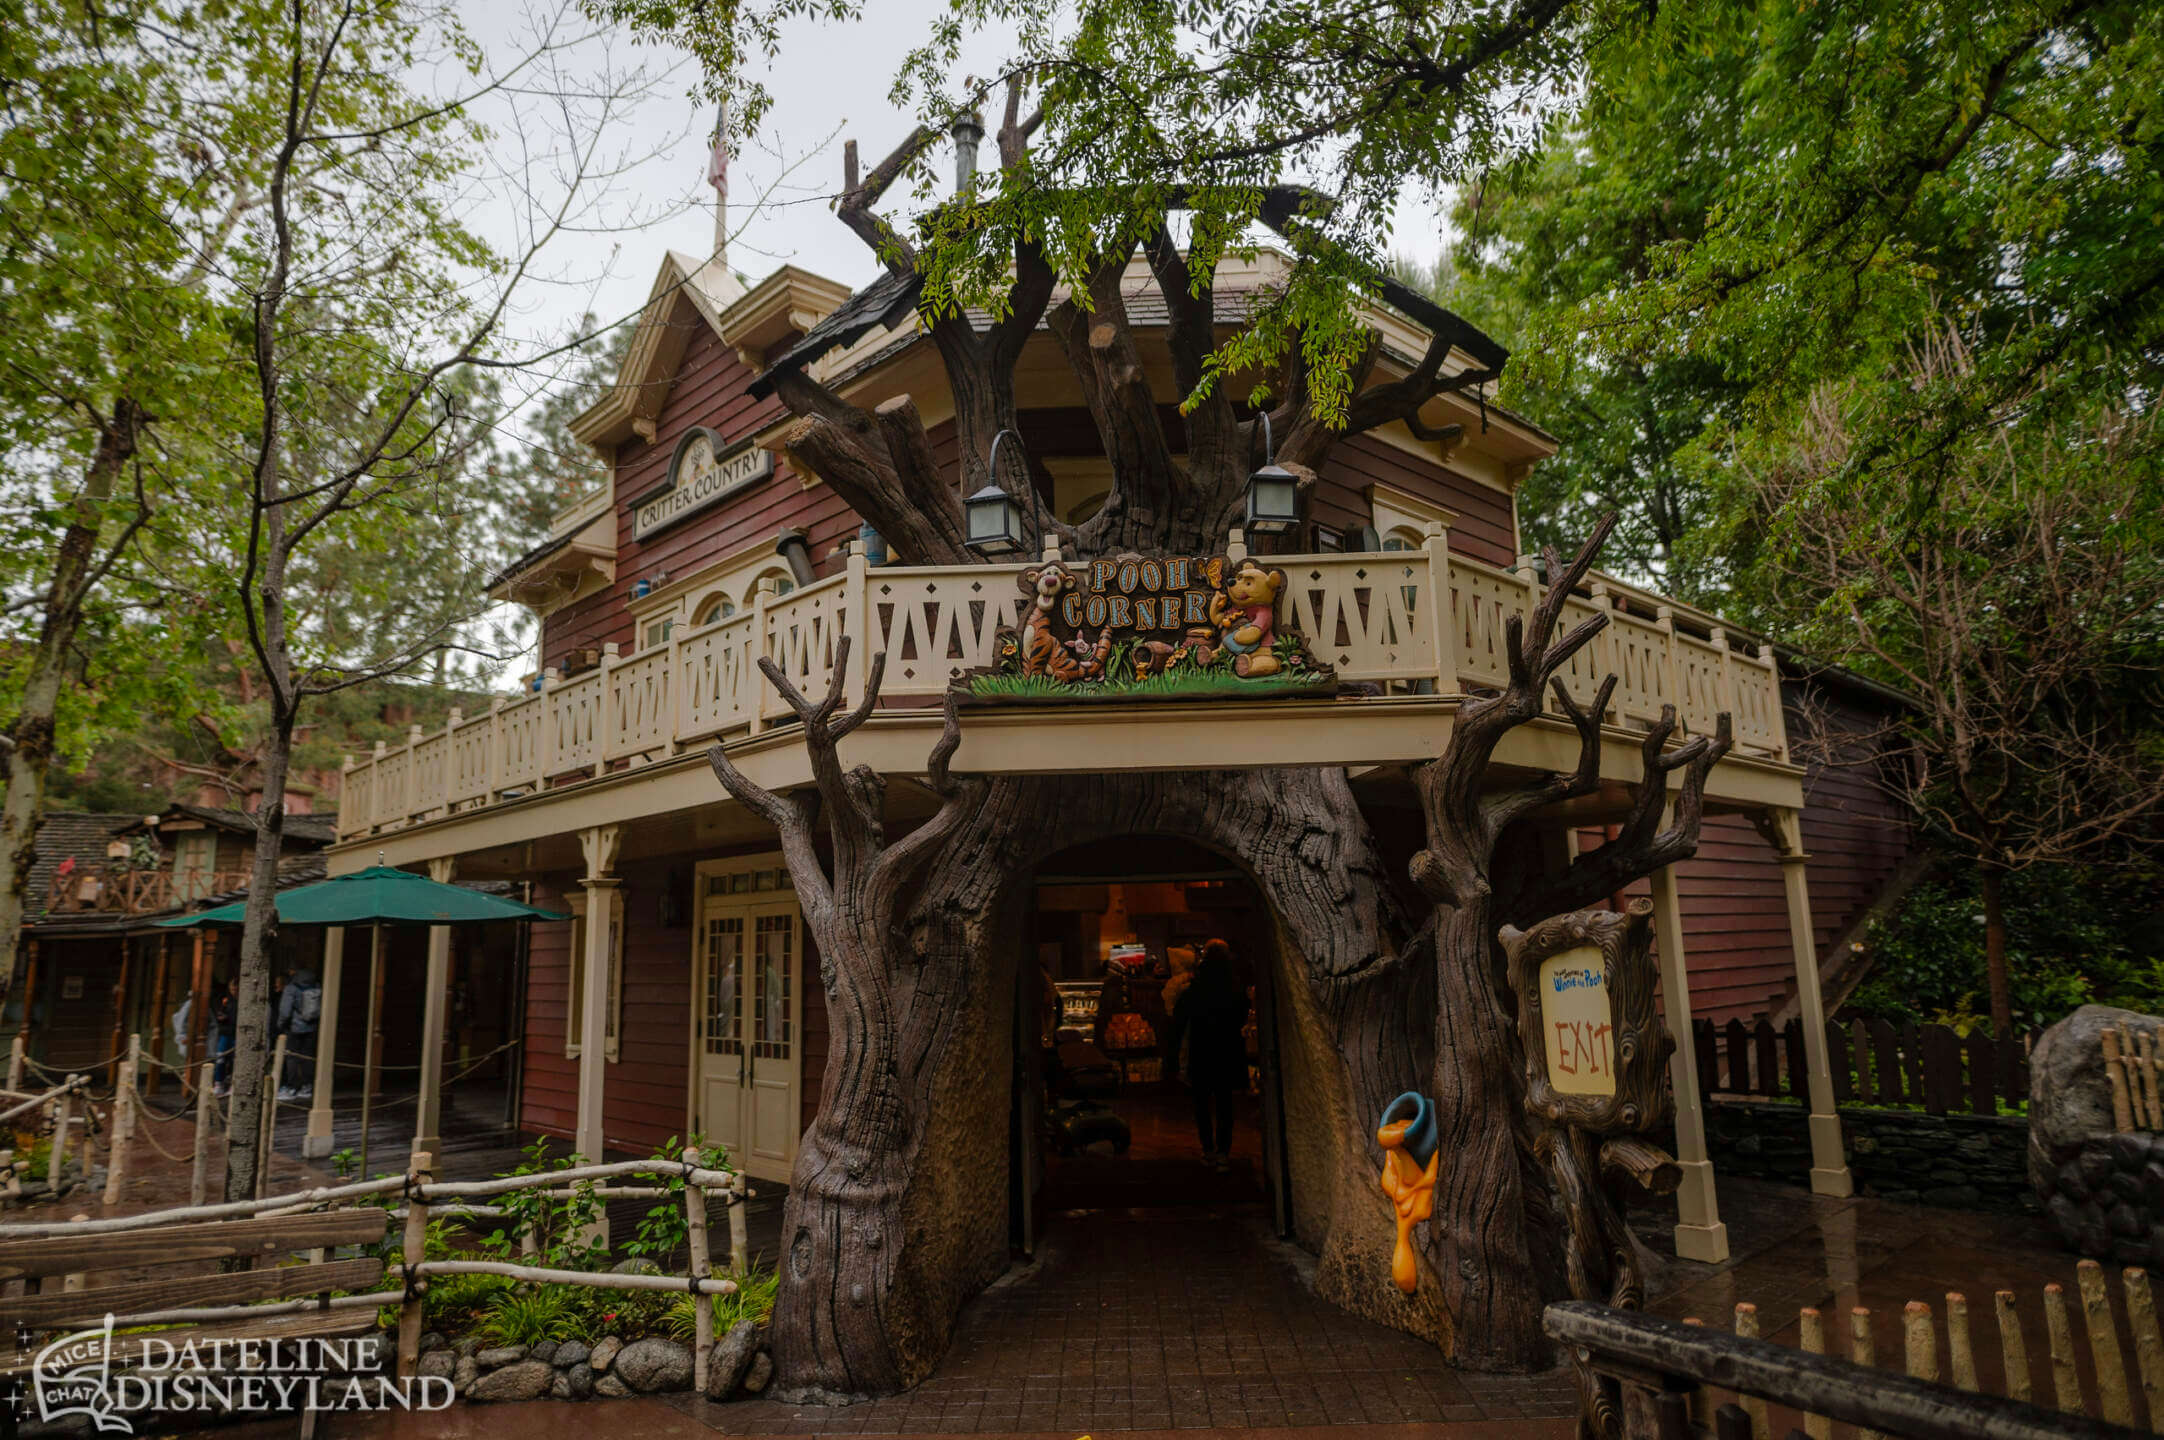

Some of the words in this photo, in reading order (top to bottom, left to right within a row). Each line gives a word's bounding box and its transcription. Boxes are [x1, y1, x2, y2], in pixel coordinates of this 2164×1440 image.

[641, 486, 692, 528] CRITTER
[694, 449, 761, 499] COUNTRY
[1091, 558, 1189, 593] POOH
[1063, 591, 1207, 630] CORNER
[1584, 969, 1602, 987] Pooh
[1555, 1020, 1612, 1078] EXIT
